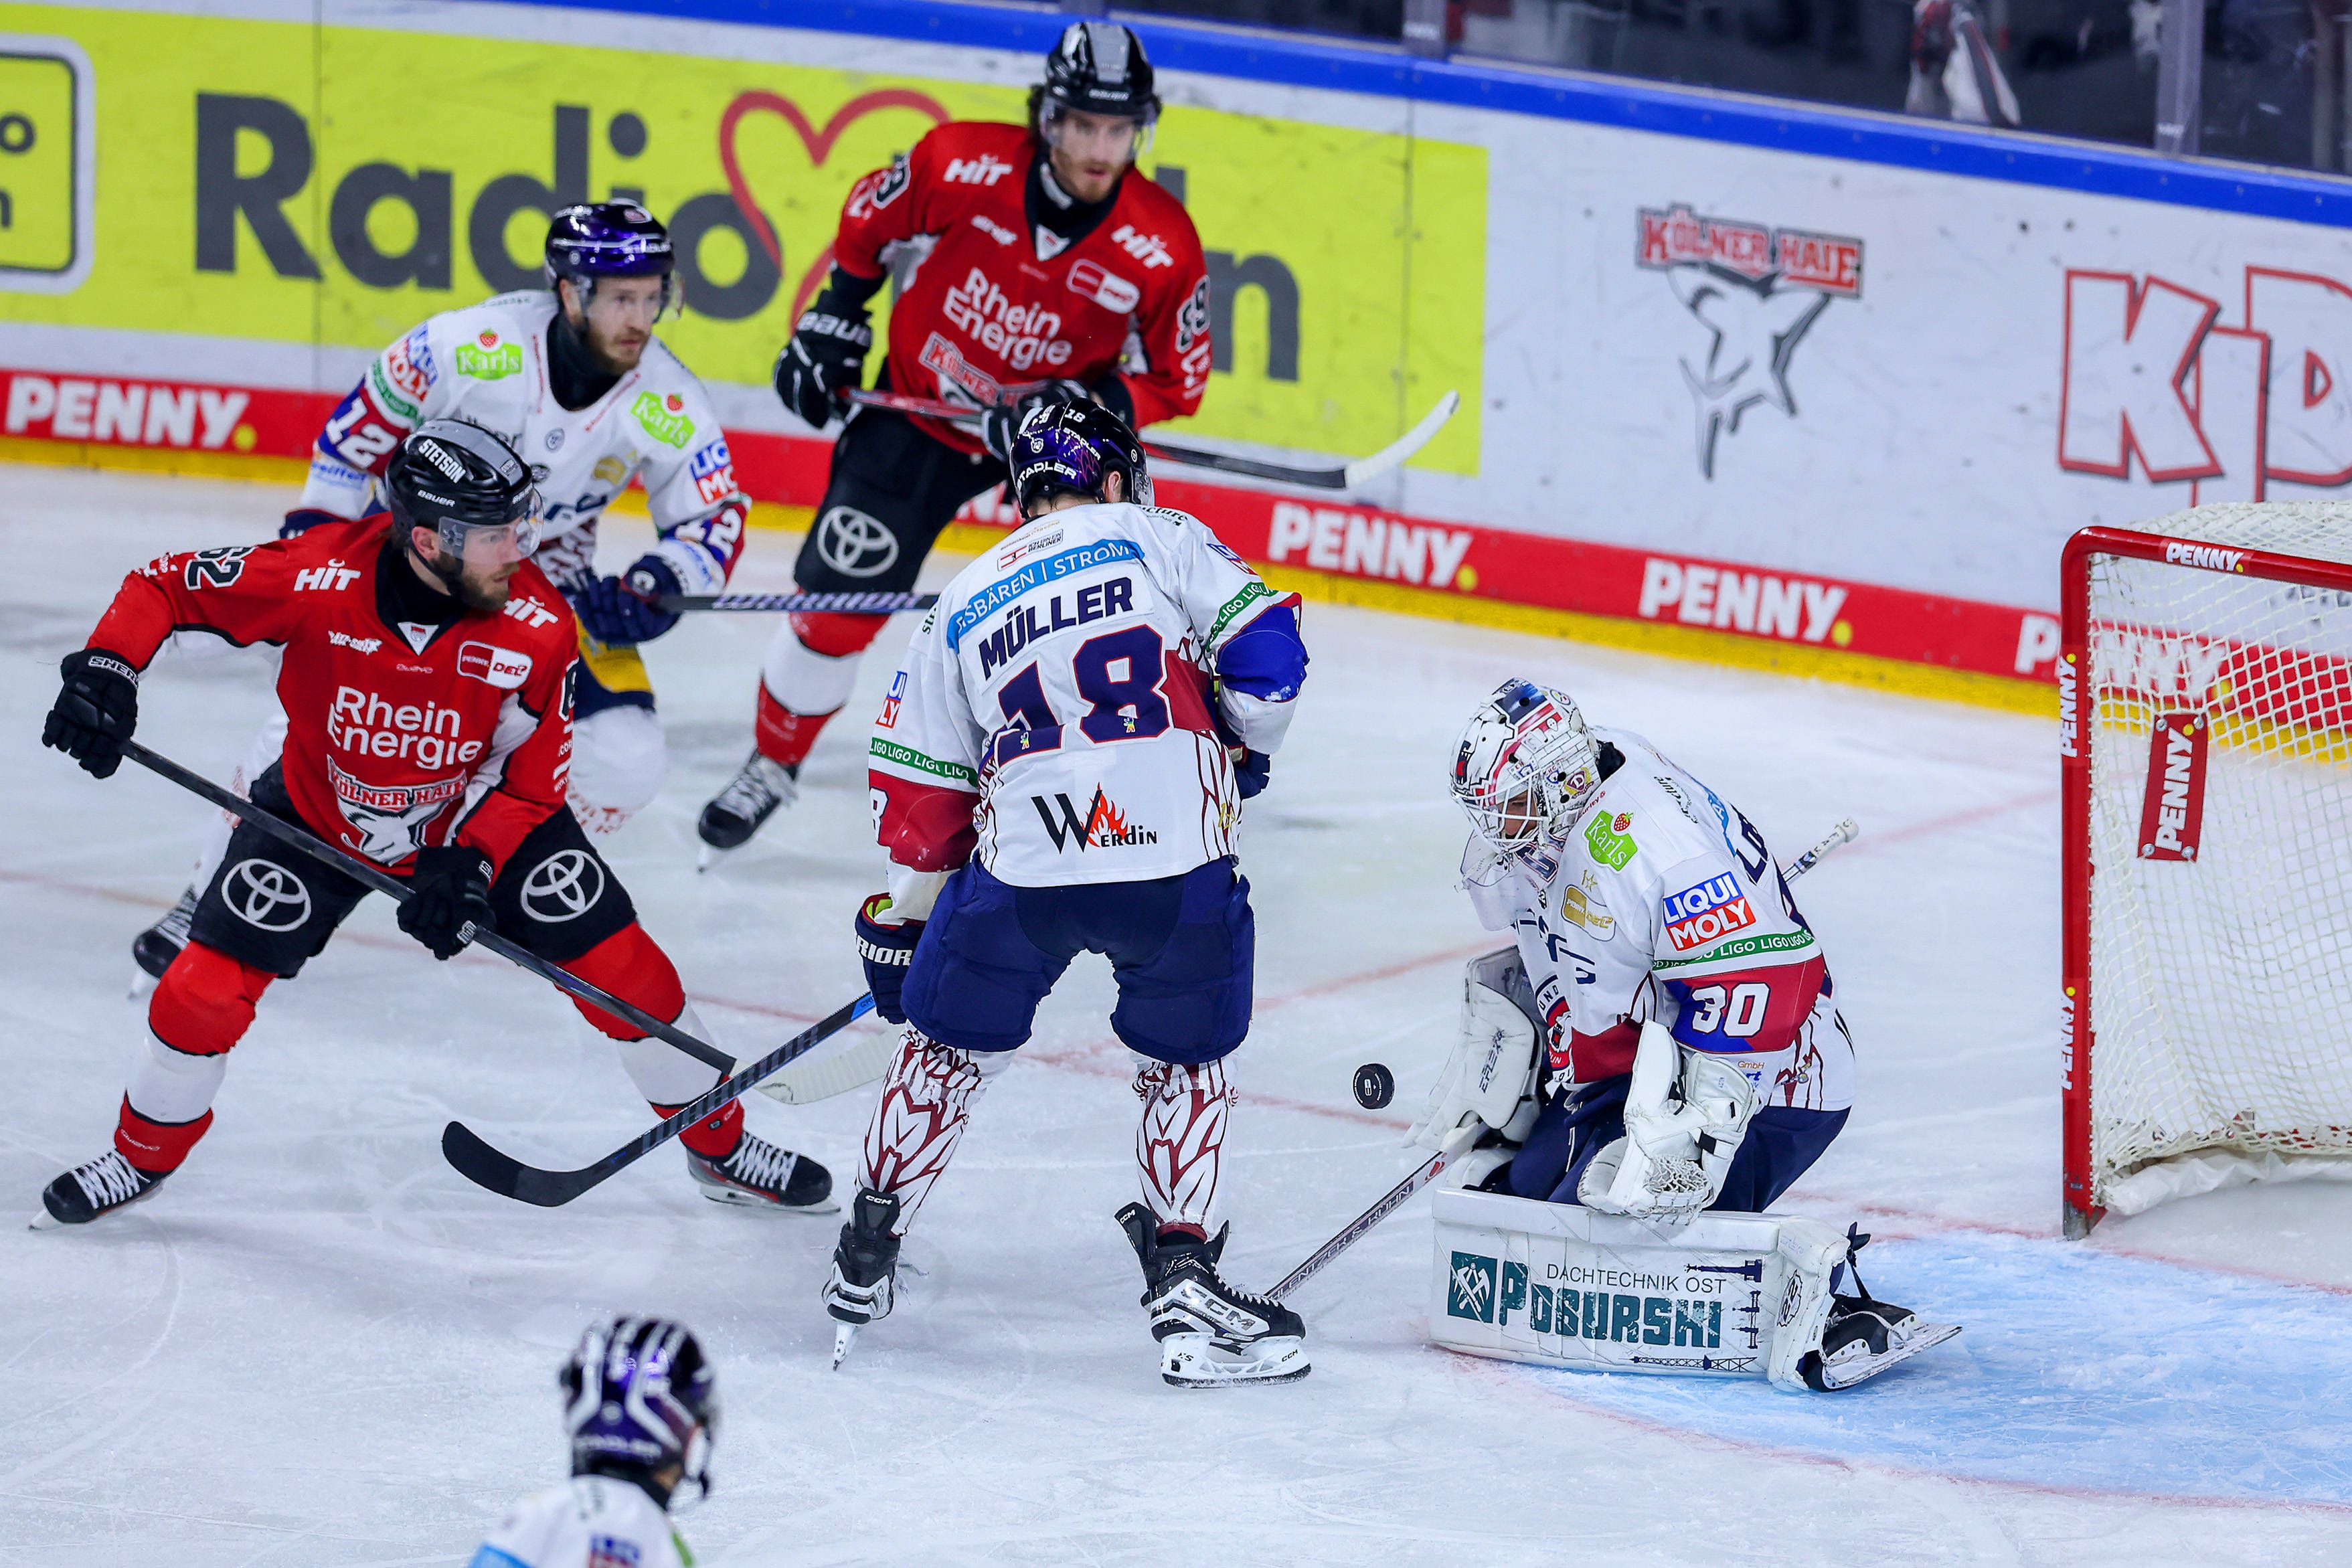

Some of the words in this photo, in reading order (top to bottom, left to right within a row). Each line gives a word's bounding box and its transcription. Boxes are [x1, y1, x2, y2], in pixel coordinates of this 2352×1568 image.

[194, 92, 782, 323] Rado
[964, 266, 1061, 338] Rhein
[942, 285, 1074, 371] Energie
[459, 349, 521, 373] Karls
[325, 396, 398, 469] 12
[635, 396, 686, 444] Karls
[1064, 409, 1086, 423] 18
[418, 438, 467, 484] STETSON
[1063, 427, 1102, 460] STADLER
[1016, 461, 1078, 491] STADLER
[417, 489, 456, 508] BAUER
[1054, 542, 1130, 576] STROM
[979, 577, 1134, 681] MÜLLER
[1219, 599, 1244, 623] LIGO
[334, 685, 461, 738] Rhein
[997, 622, 1167, 769] 18
[327, 703, 483, 770] Energie
[888, 745, 912, 762] LIGO
[332, 770, 408, 809] KÖLNER
[1588, 817, 1627, 865] Karls
[1663, 873, 1740, 924] LIQUI
[1669, 897, 1747, 949] MOLY
[1719, 941, 1756, 956] LIGO
[1760, 936, 1788, 950] LIGO
[1691, 982, 1770, 1037] 30
[1737, 1060, 1765, 1069] GmbH
[865, 1194, 893, 1205] CCM
[1118, 1207, 1137, 1225] CCM
[1547, 1263, 1679, 1292] DACHTECHNIK
[1686, 1276, 1727, 1294] OST
[1181, 1285, 1256, 1332] CCM
[1281, 1348, 1298, 1363] CCM
